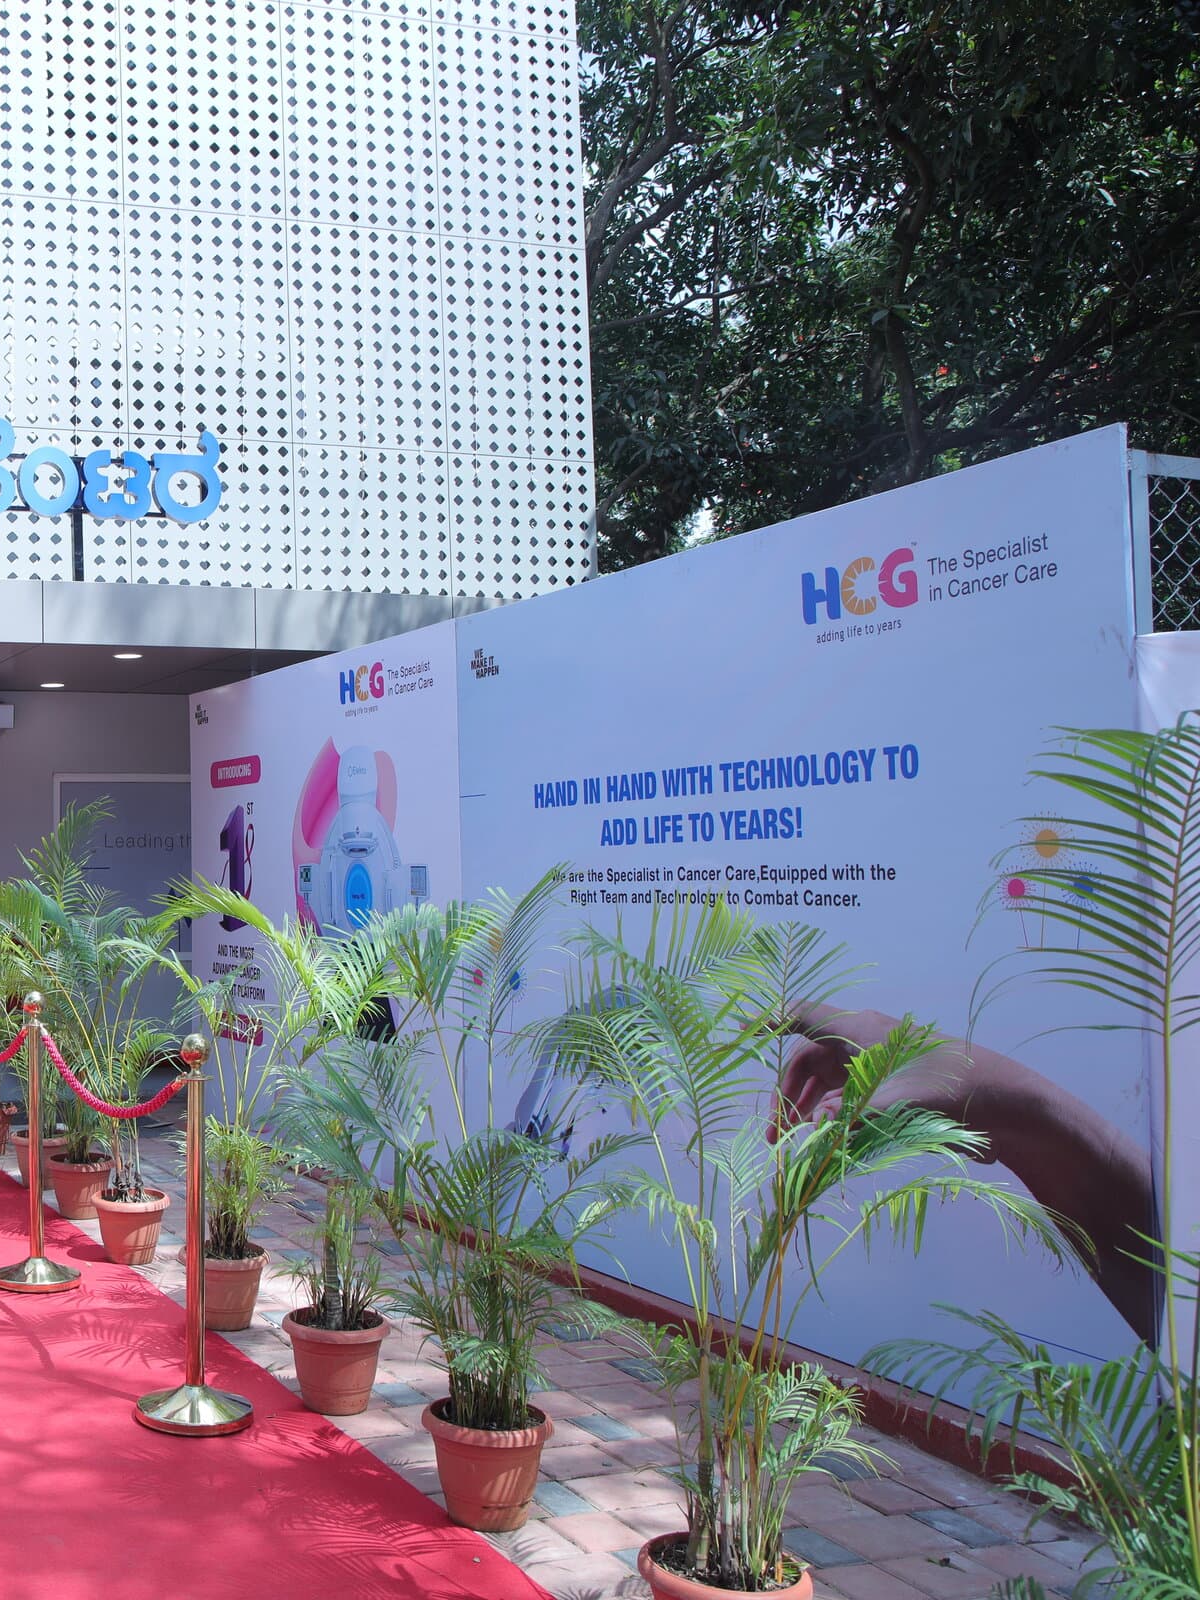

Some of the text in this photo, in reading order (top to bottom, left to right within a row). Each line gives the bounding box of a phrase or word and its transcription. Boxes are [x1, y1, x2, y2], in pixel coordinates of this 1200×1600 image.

[927, 532, 1049, 577] The Specialist
[801, 547, 919, 625] HCG
[928, 562, 1058, 602] in Cancer Care
[816, 618, 902, 645] adding life to years
[387, 660, 431, 681] The Specialist
[476, 665, 498, 678] HAPPEN
[339, 661, 385, 705] HCG
[387, 677, 434, 697] in Cancer Care
[216, 763, 252, 781] INTRODUCING
[534, 744, 919, 809] HAND IN HAND WITH TECHNOLOGY TO
[600, 806, 803, 846] ADD LIFE TO YEARS!
[104, 832, 174, 852] Leading
[568, 870, 585, 882] are
[587, 868, 604, 883] the
[606, 866, 660, 886] Specialist
[663, 866, 674, 881] in
[677, 866, 721, 882] Cancer
[831, 864, 865, 881] with
[870, 864, 896, 881] the
[570, 888, 597, 907] Right
[599, 889, 628, 904] Team
[631, 889, 652, 904] and
[727, 889, 740, 905] to
[744, 888, 799, 906] Combat
[803, 889, 861, 907] Cancer.
[217, 943, 255, 960] AND THE MOST
